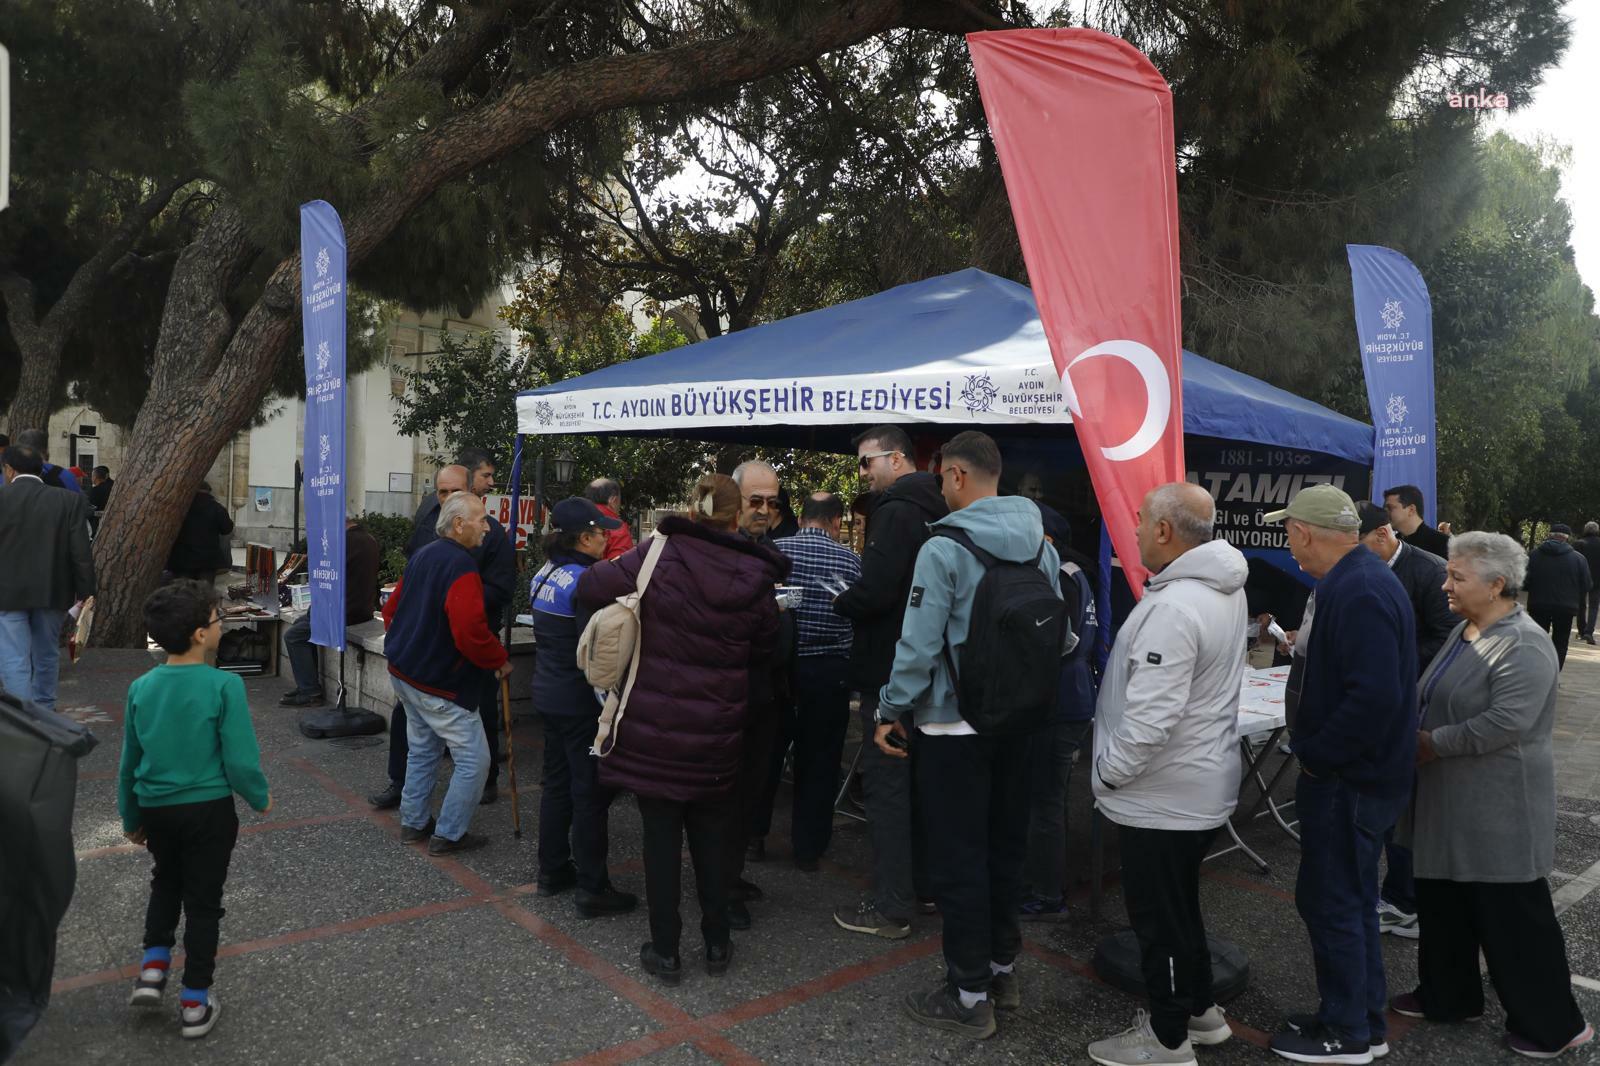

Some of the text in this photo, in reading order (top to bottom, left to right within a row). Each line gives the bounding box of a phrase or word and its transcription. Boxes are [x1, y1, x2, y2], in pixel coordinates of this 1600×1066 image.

[1018, 381, 1044, 390] AYDIN
[592, 380, 951, 420] T.C. AYDIN BÜYÜKŞEHİR BELEDİYESİ
[1002, 392, 1063, 405] BÜYÜKŞEHİR
[1009, 405, 1055, 414] BELEDİYESİ
[1232, 514, 1250, 526] ve
